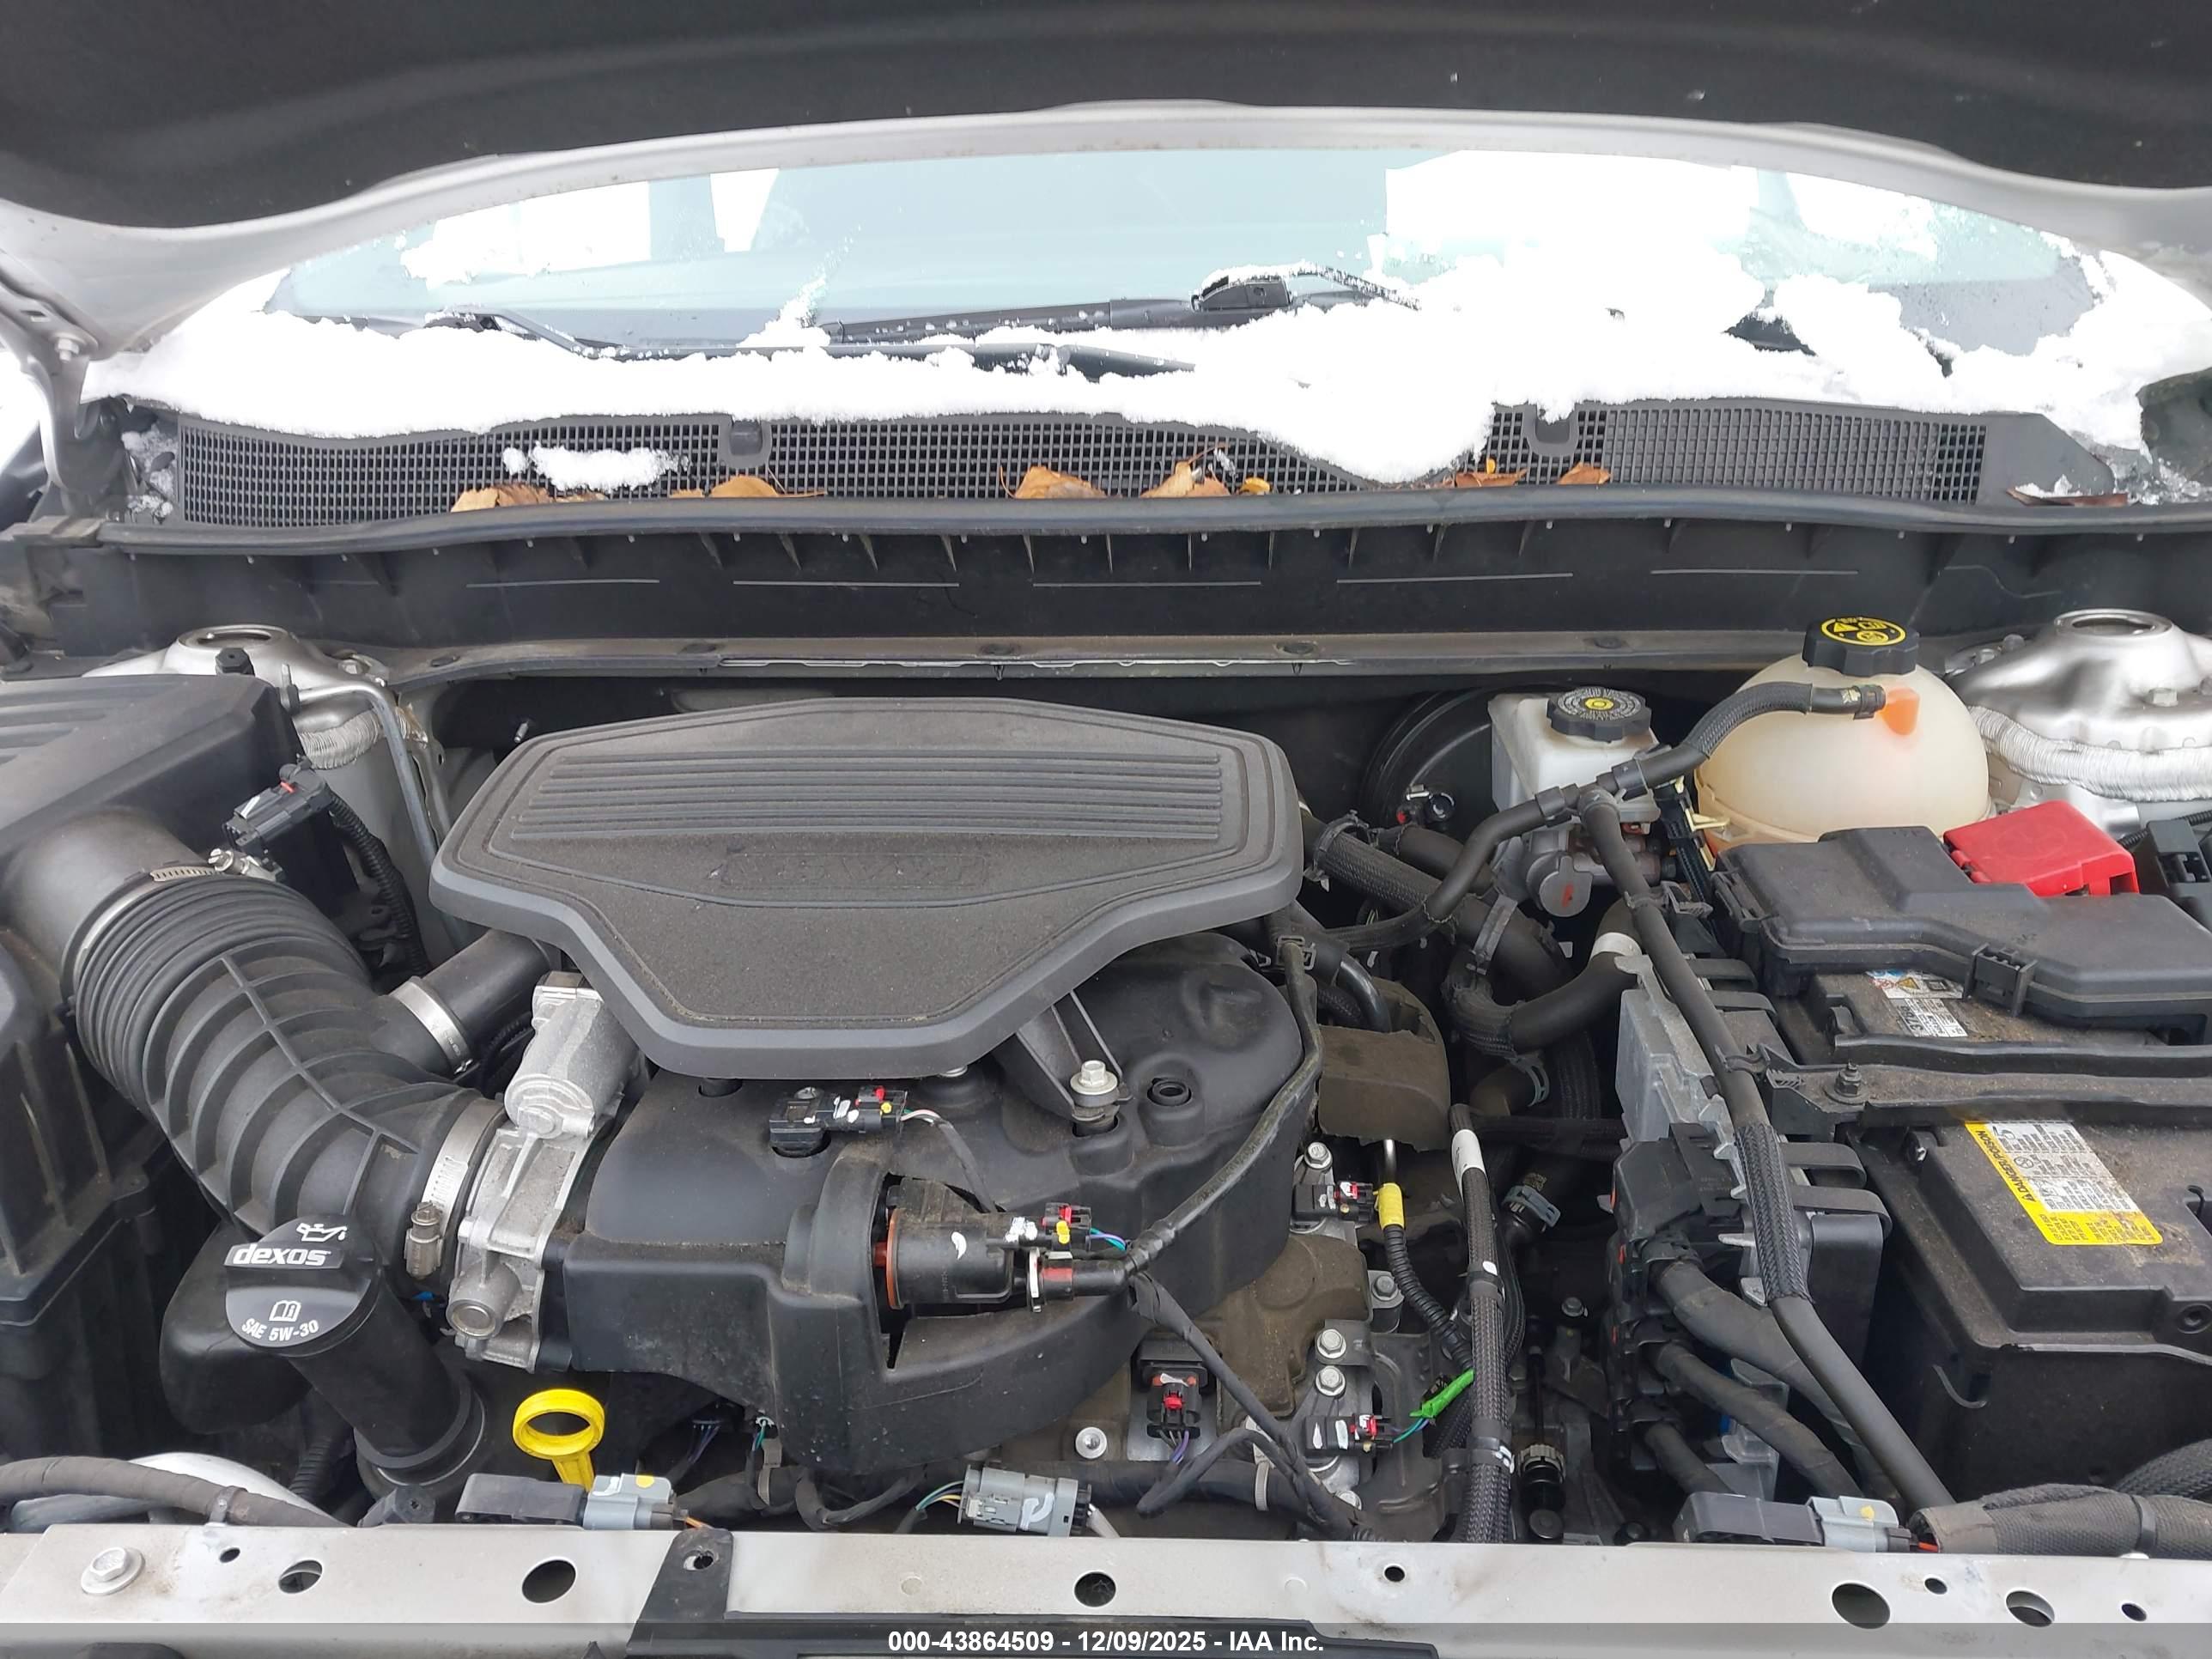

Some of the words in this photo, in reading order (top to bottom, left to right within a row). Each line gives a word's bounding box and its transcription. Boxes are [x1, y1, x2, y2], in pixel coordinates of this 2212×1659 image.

[233, 1243, 327, 1267] dexos
[241, 1318, 267, 1339] SAE
[268, 1319, 319, 1341] 5W-30
